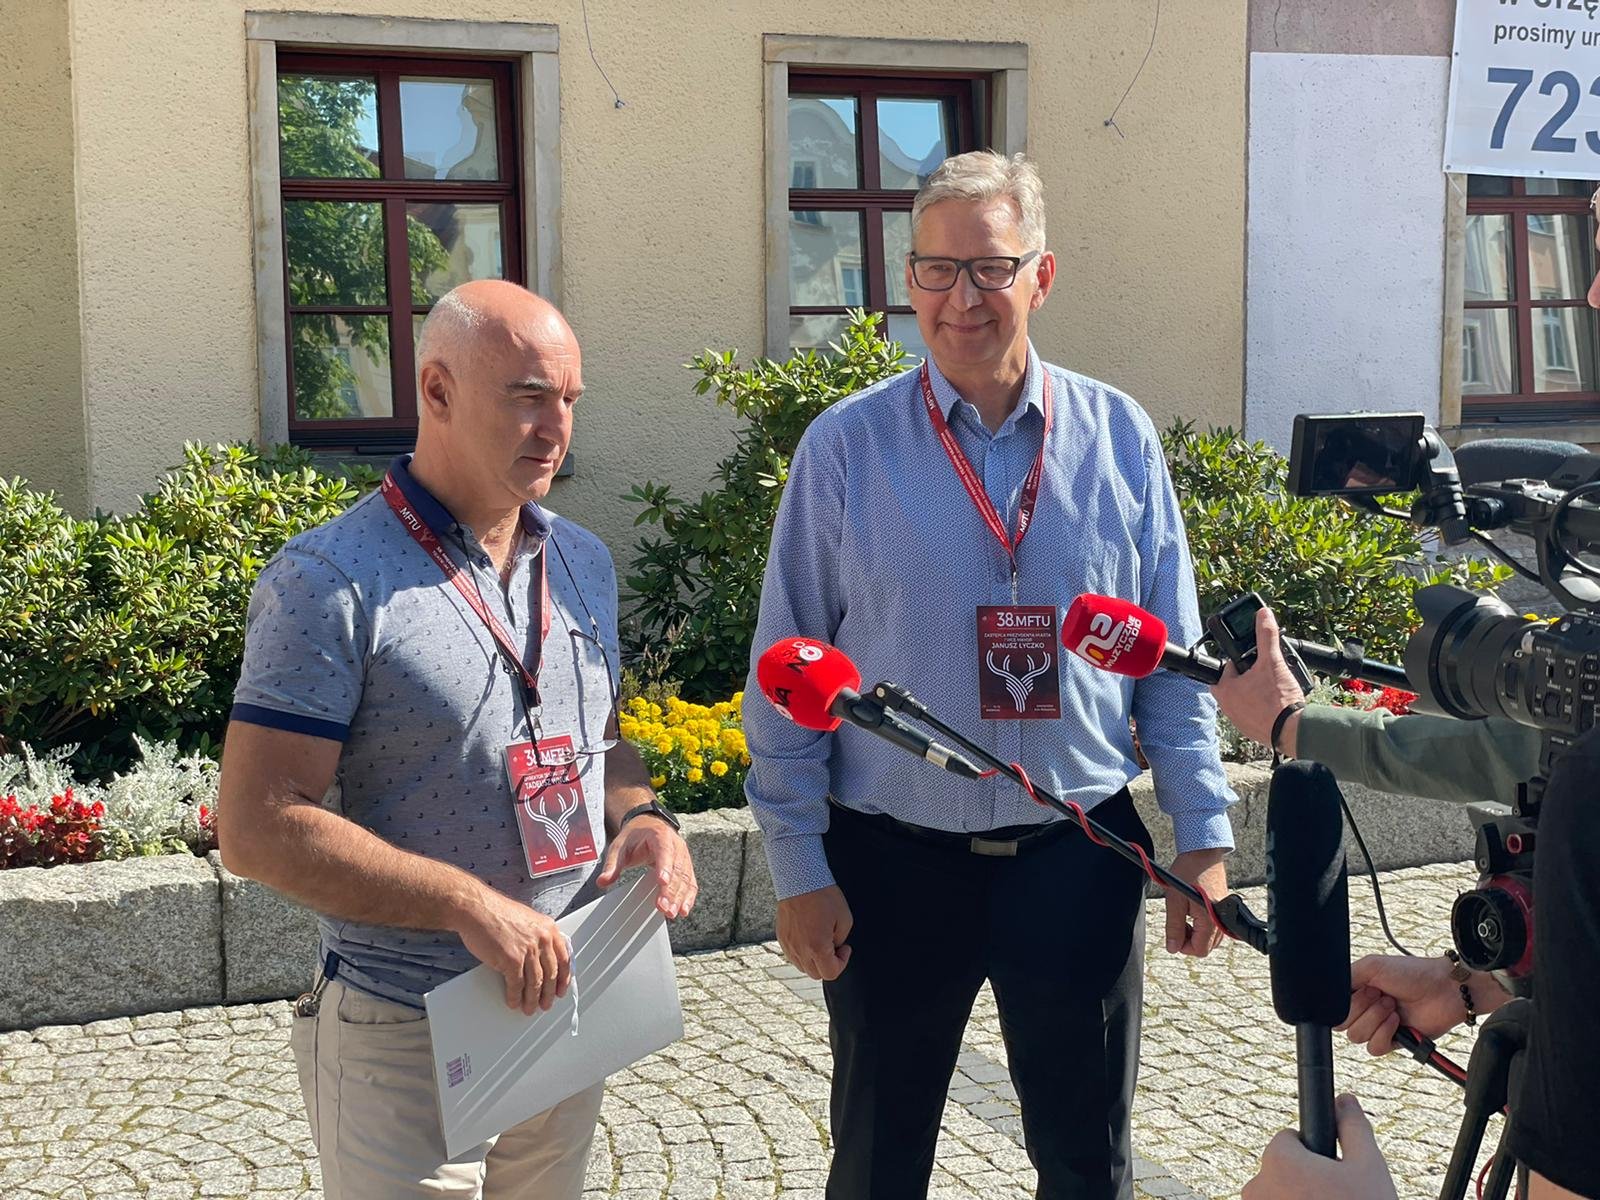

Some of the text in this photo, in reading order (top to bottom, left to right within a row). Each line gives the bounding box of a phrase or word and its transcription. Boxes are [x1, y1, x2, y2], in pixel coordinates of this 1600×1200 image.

[1494, 23, 1576, 49] prosimy
[1104, 614, 1136, 668] MUZYCZNE
[1124, 618, 1143, 652] RADIO
